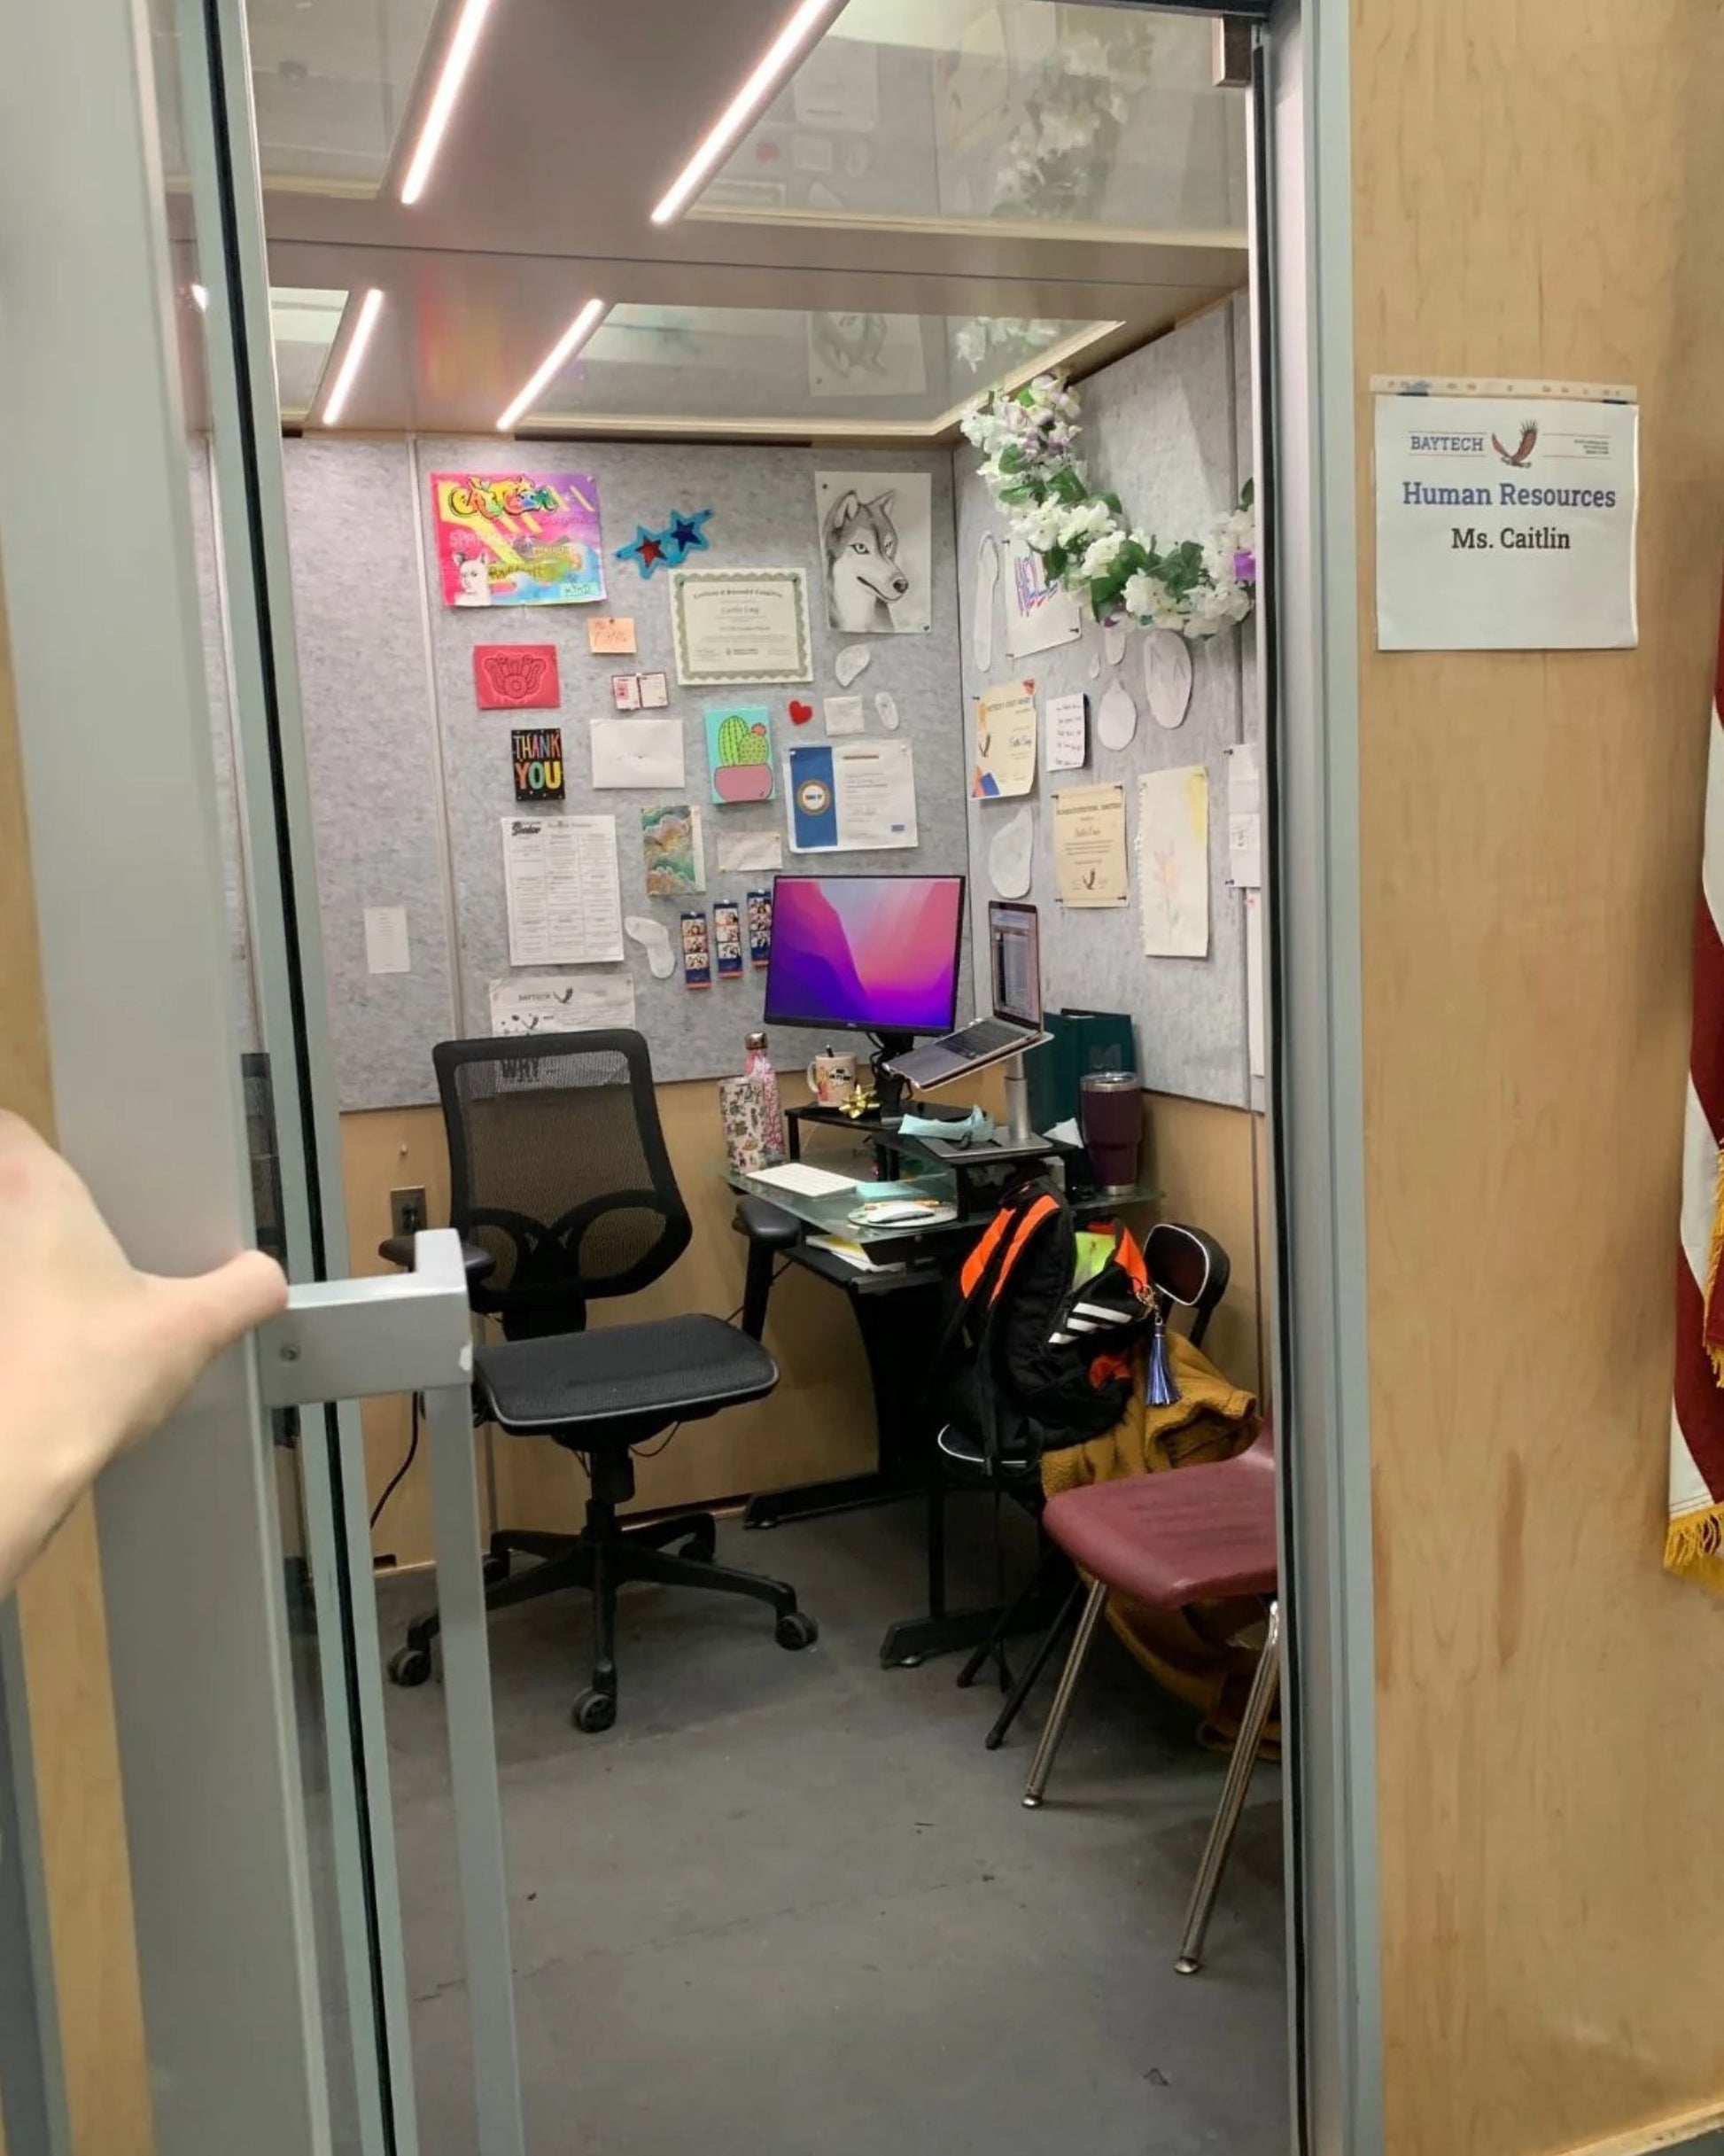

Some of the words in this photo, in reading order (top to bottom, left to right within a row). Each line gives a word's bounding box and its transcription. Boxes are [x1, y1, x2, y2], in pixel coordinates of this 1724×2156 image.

[1410, 436, 1484, 452] BAYTECH
[1402, 482, 1492, 506] Human
[1499, 483, 1617, 508] Resources
[1451, 528, 1495, 549] Ms.
[1500, 527, 1571, 549] Caitlin
[513, 734, 561, 759] THANK
[515, 761, 562, 790] YOU
